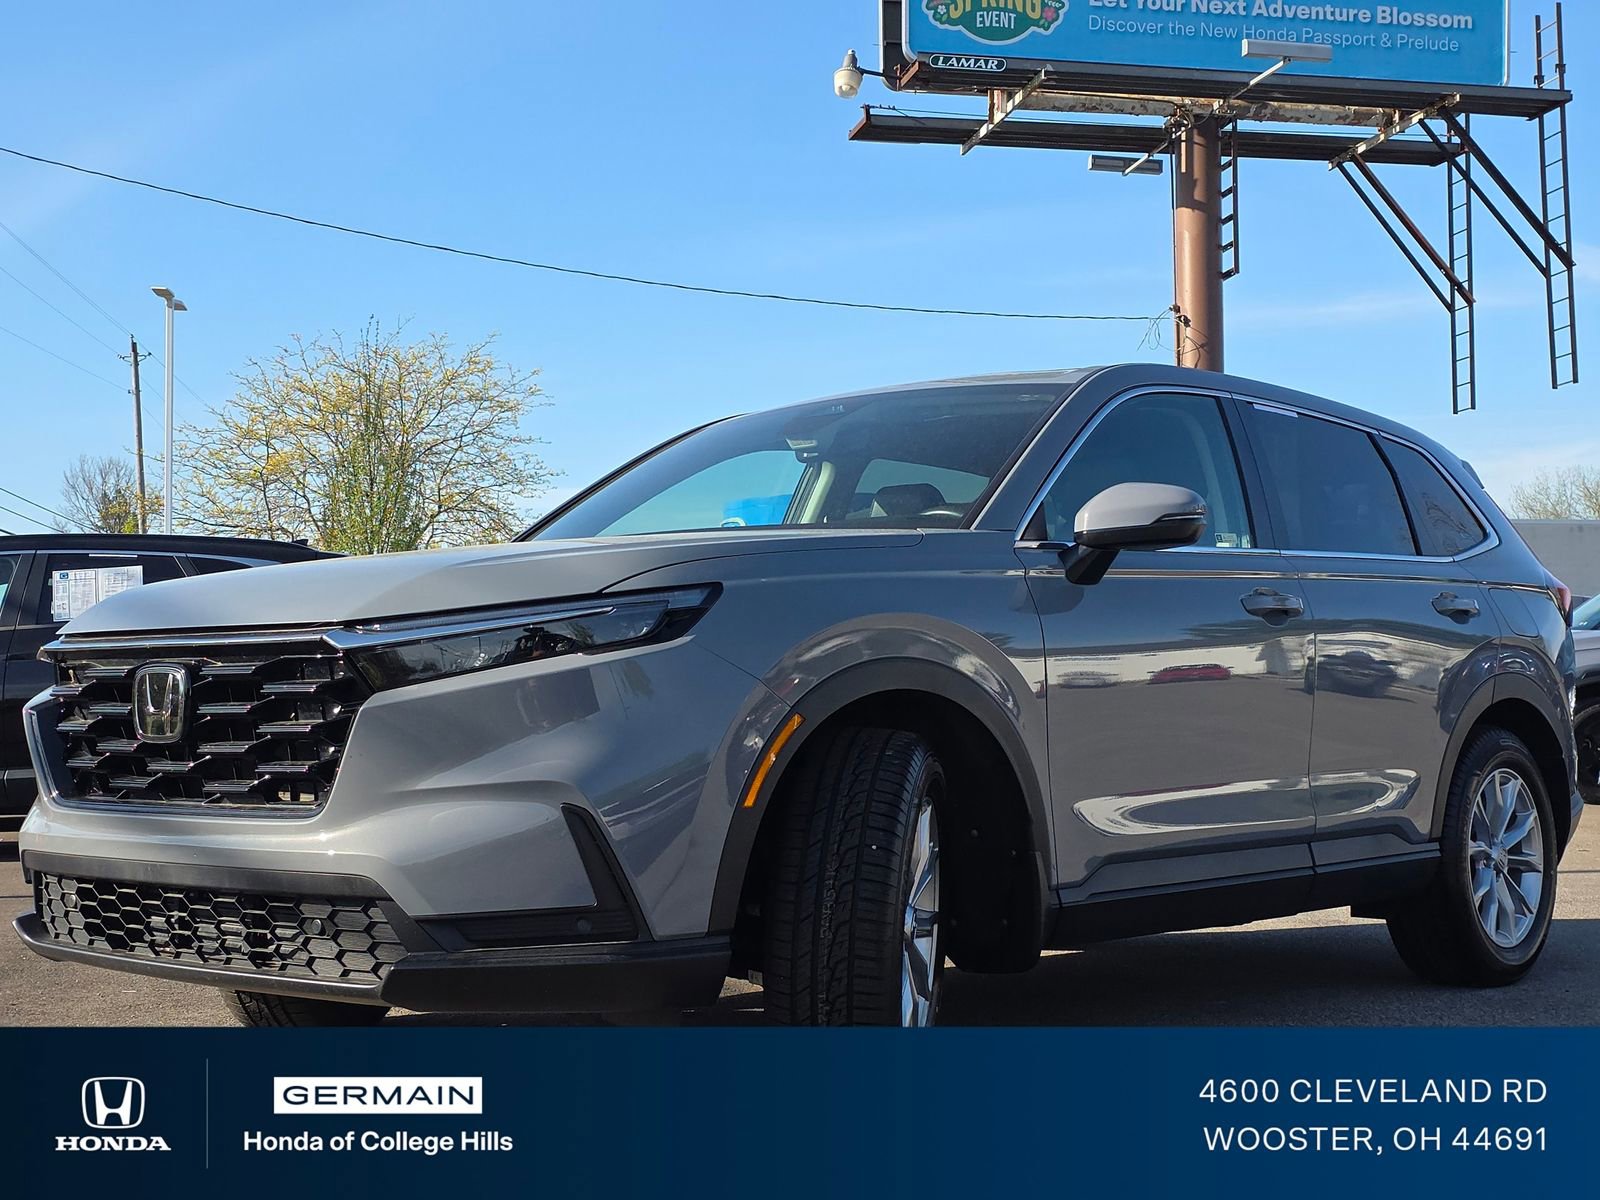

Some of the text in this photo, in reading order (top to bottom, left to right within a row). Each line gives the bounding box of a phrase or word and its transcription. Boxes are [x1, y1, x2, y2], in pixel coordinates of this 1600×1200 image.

[976, 11, 1017, 29] EVENT
[1191, 0, 1246, 16] Next
[1252, 0, 1371, 23] Adventure
[1377, 6, 1473, 29] Blossom
[1088, 15, 1459, 51] Discover the New Honda Passport & Prelude
[937, 56, 999, 70] LAMAR
